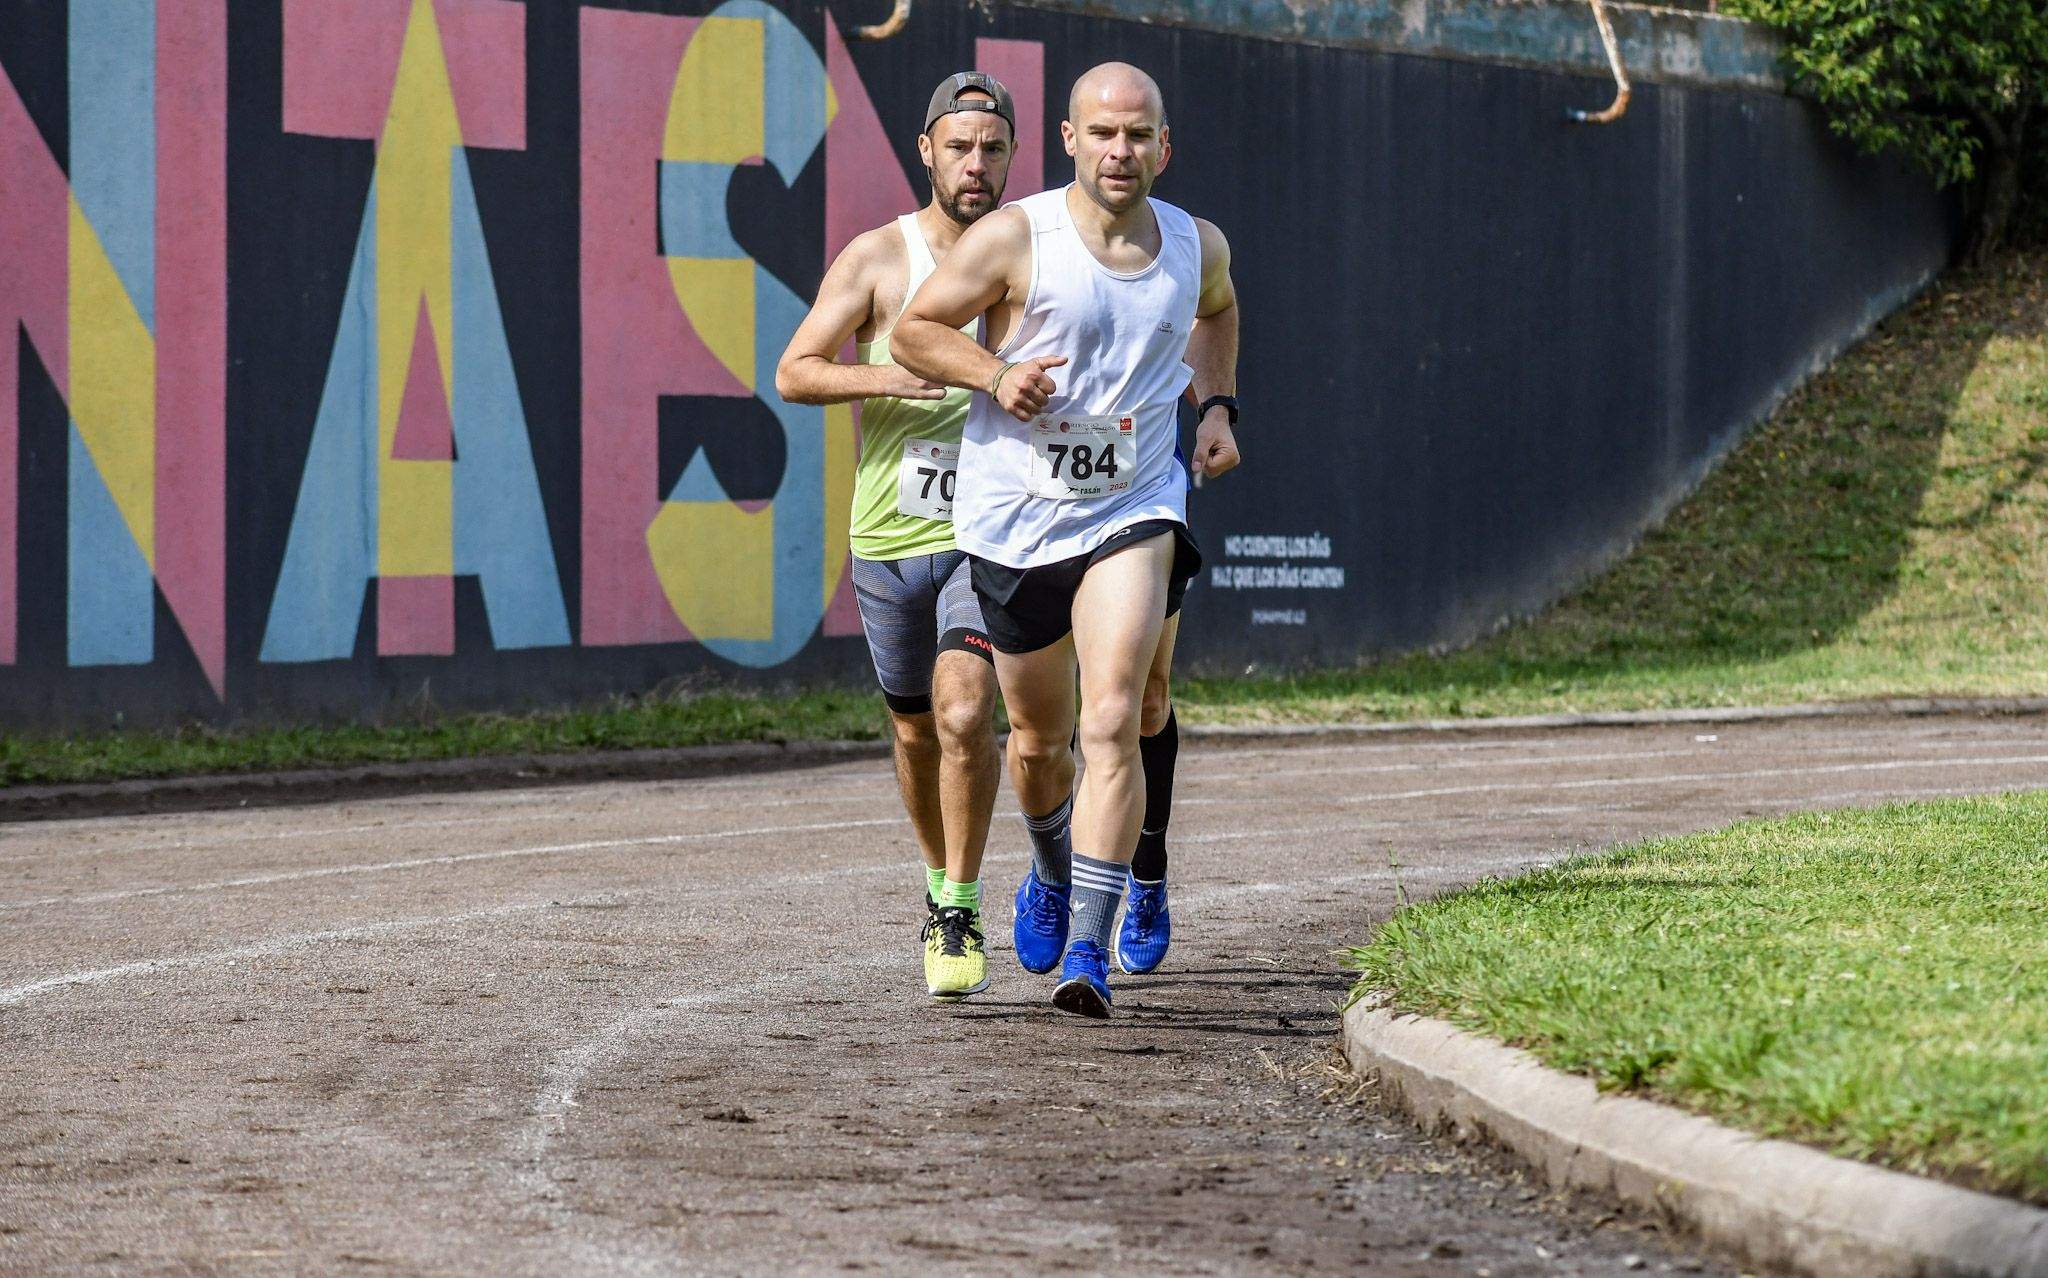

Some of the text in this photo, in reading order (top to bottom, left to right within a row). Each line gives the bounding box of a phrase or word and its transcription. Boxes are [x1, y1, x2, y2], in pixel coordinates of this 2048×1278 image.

[1047, 443, 1118, 481] 784
[1108, 481, 1128, 491] 2023
[1225, 535, 1242, 557] NO
[1288, 536, 1308, 558] LOS
[1233, 566, 1253, 590] QUE
[1255, 566, 1275, 588] LOS
